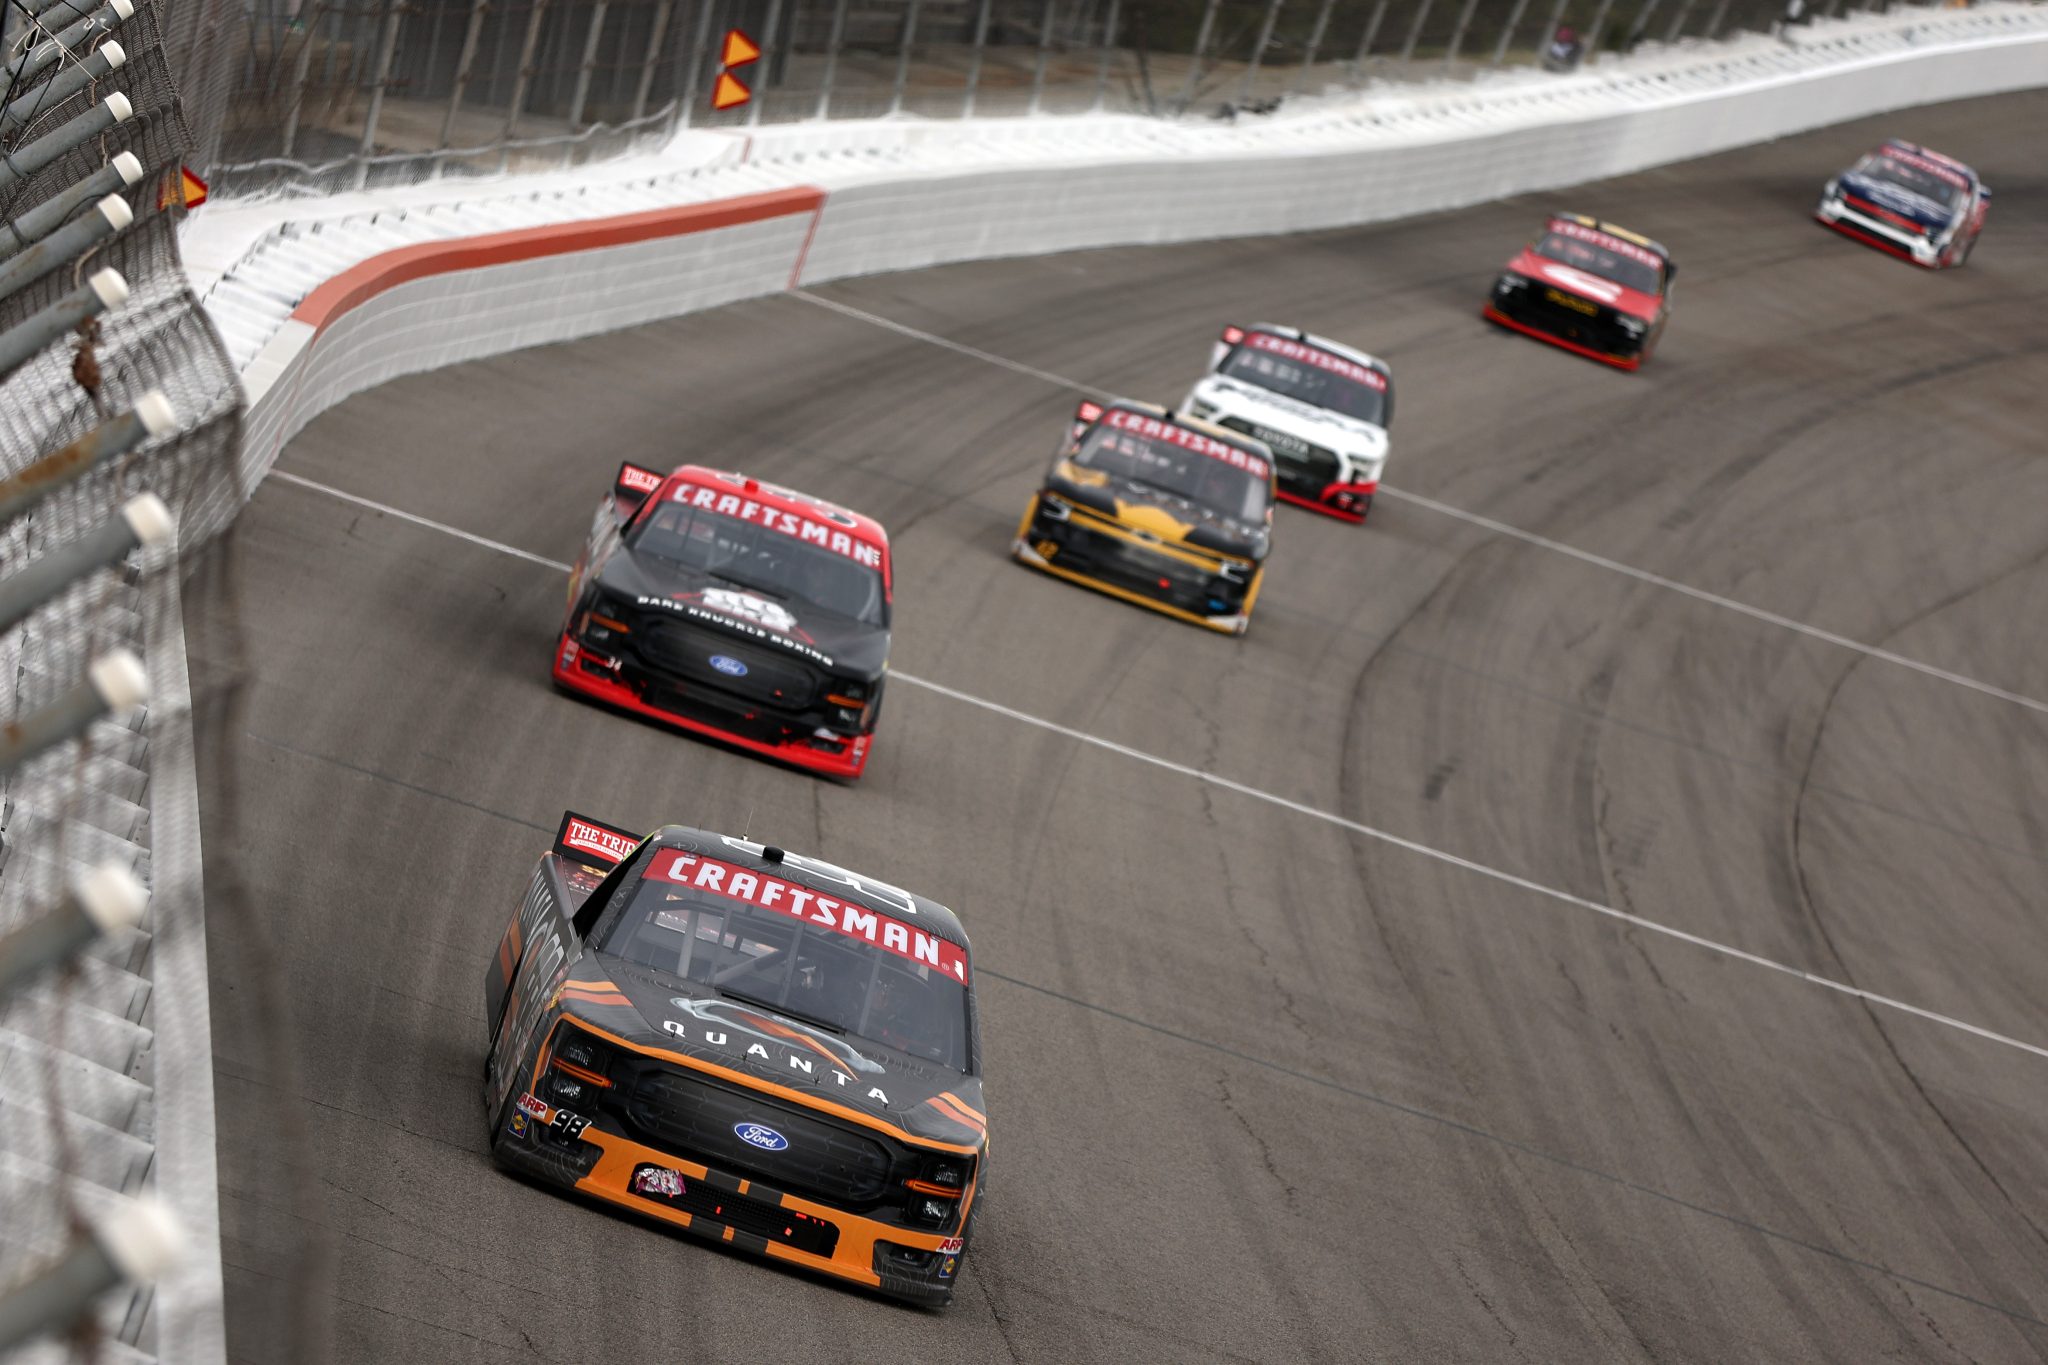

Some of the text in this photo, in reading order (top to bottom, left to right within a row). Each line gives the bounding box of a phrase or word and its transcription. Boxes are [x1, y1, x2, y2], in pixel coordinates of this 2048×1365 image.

[1110, 407, 1264, 475] CRAFTSMAN
[673, 484, 875, 566] CRAFTSMAN
[688, 607, 767, 639] KNUCKLE
[770, 633, 834, 668] BOXING
[570, 822, 600, 843] THE
[668, 856, 940, 967] CRAFTSMAN
[663, 1020, 889, 1105] QUANTA
[517, 1093, 547, 1113] ARP
[549, 1108, 592, 1139] 98
[743, 1126, 779, 1148] Ford
[940, 1238, 964, 1251] ARP
